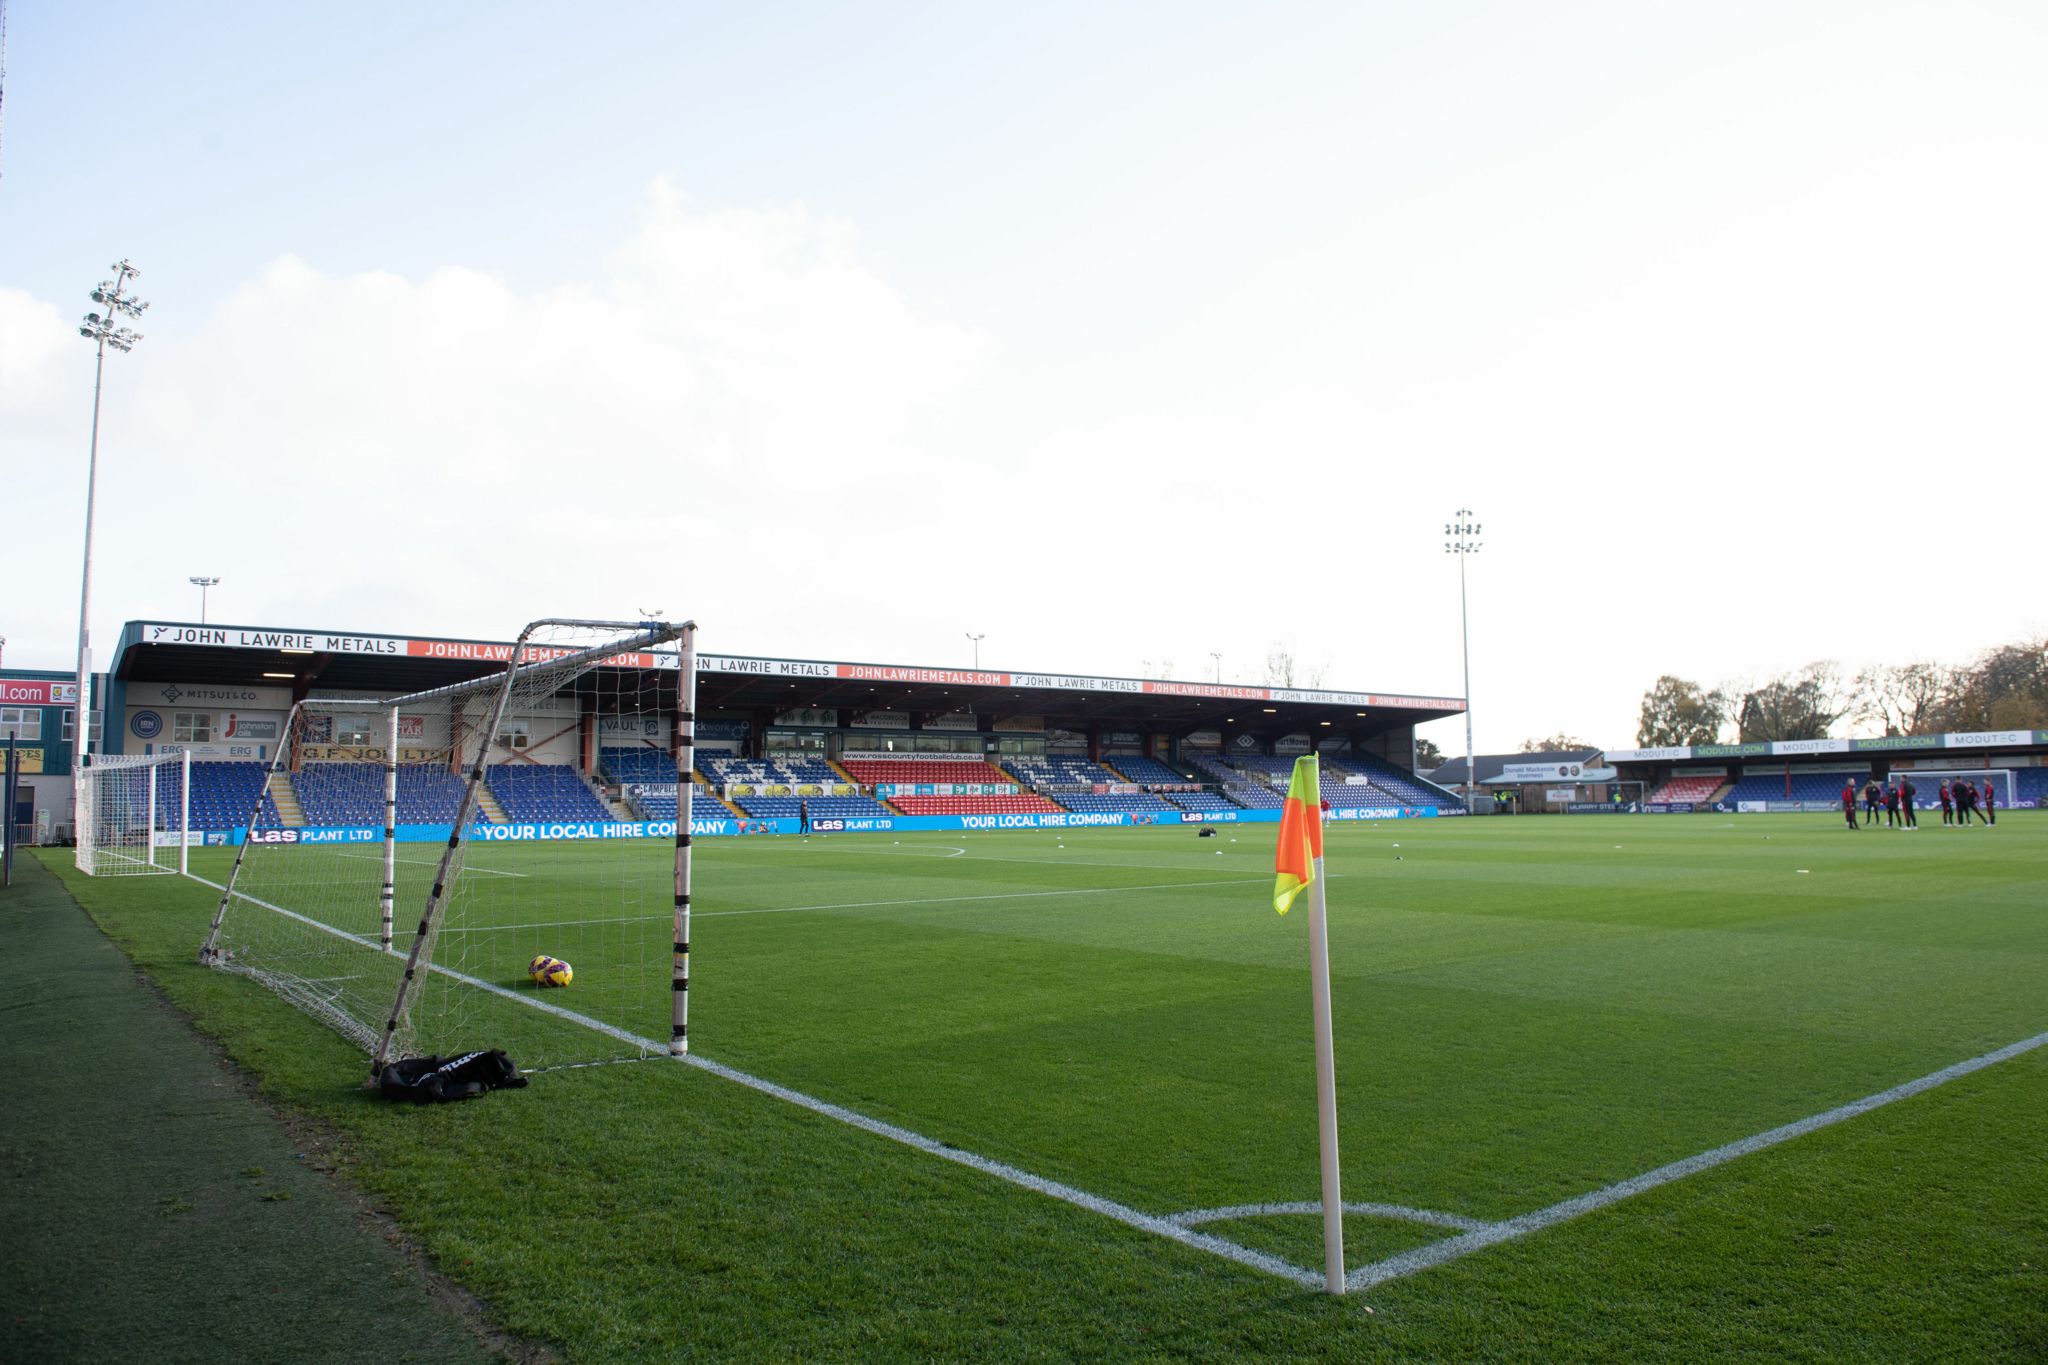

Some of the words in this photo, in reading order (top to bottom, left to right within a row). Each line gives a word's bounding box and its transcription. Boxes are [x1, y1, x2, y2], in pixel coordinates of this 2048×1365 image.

[173, 628, 226, 644] JOHN
[240, 632, 314, 649] LAWRIE
[327, 637, 397, 653] METALS
[674, 657, 711, 669] JHN
[720, 659, 771, 673] LAWRIE
[780, 663, 830, 676] METALS
[849, 667, 1000, 685] JOHNLAWRIEMETALS.COM
[1025, 676, 1051, 687] JOHN
[1058, 678, 1095, 689] LAWRIE
[1101, 681, 1138, 691] METALS
[1151, 683, 1264, 699] JOHNLAWRIEMETALS.COM
[1280, 692, 1301, 701] JOHN
[1305, 693, 1333, 702] LAWRIE
[1338, 695, 1365, 704] METALS
[1375, 697, 1460, 710] JOHNLAWRIEMETALS.COM
[399, 726, 422, 734] TAR
[605, 720, 645, 731] VAULT
[695, 721, 730, 731] ckwork
[1857, 737, 1936, 748] MODUTEC.COM
[161, 745, 184, 754] ERG
[230, 746, 252, 755] ERG
[1698, 745, 1765, 755] MODUTEC.COM
[1204, 813, 1223, 821] PLANT
[1338, 809, 1356, 818] HIRE
[1356, 808, 1399, 818] COMPANY
[846, 821, 873, 829] PLANT
[876, 820, 892, 828] LTD
[961, 817, 996, 828] YOUR
[999, 816, 1037, 827] LOCAL
[1040, 815, 1067, 826] HIRE
[1069, 813, 1124, 825] COMPANY
[301, 831, 344, 841] PLANT
[349, 830, 373, 841] LTD
[482, 825, 536, 840] YOUR
[540, 824, 599, 839] LOCAL
[603, 823, 644, 838] HIRE
